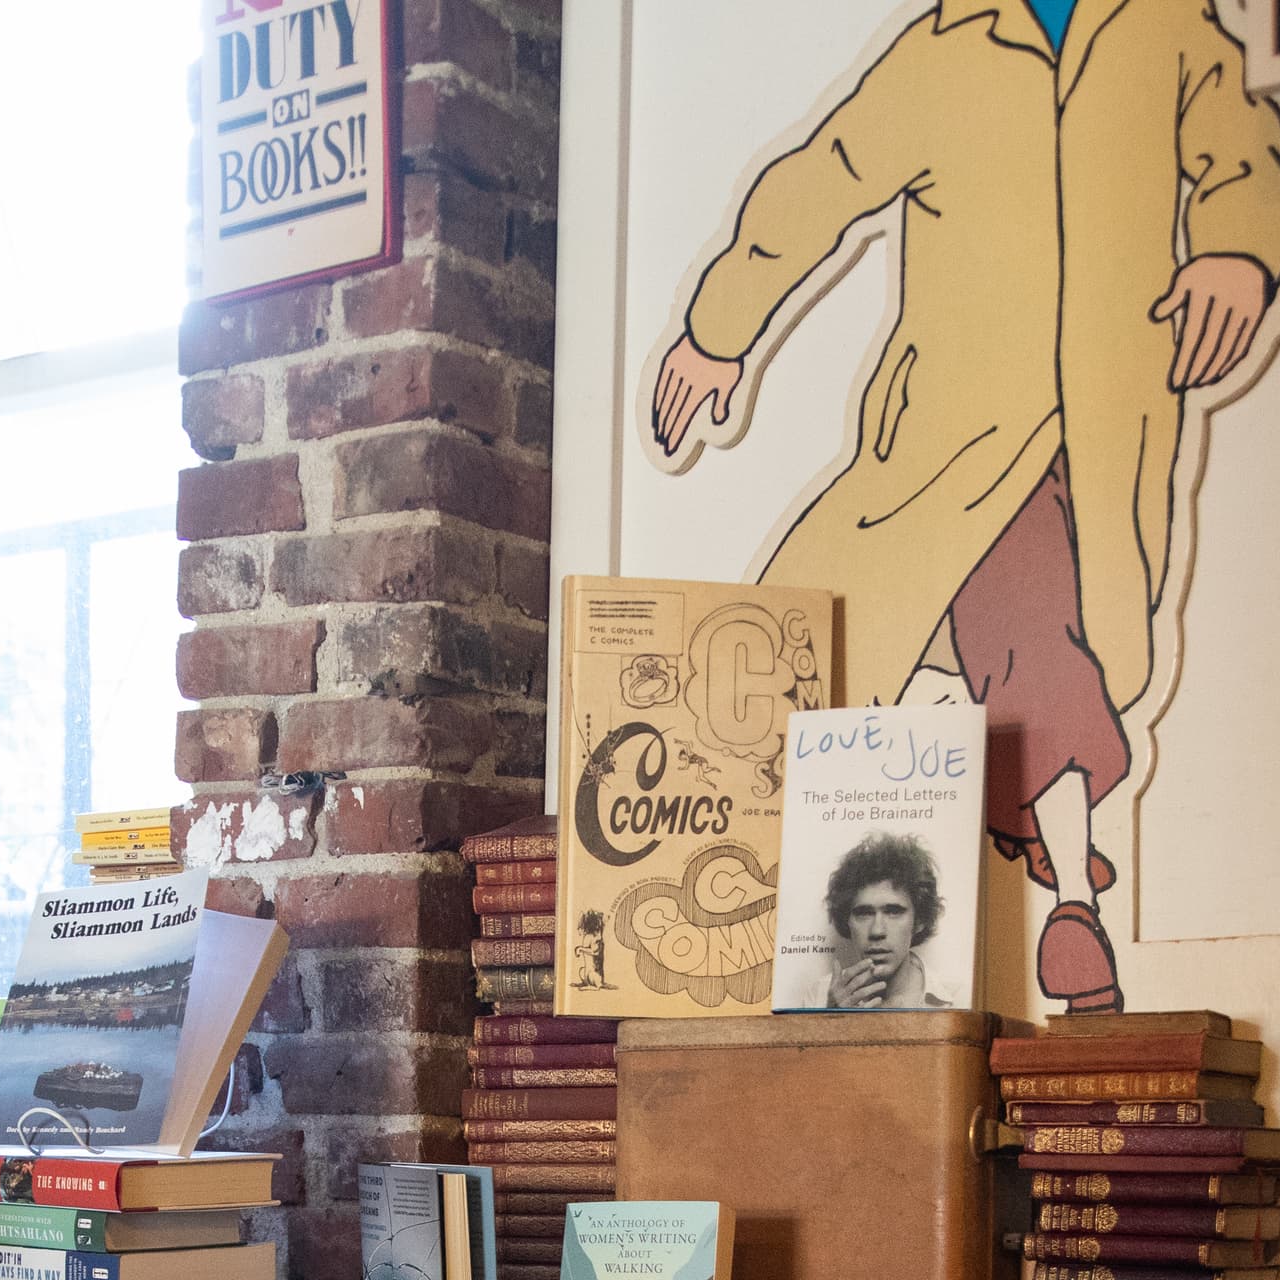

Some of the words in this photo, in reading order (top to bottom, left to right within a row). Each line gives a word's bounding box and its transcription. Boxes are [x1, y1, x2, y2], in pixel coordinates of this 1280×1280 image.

[217, 0, 361, 104] DUTY
[273, 89, 310, 127] ON
[218, 113, 367, 215] BOOKS!!
[589, 626, 606, 634] THE
[611, 626, 655, 636] COMPLETE
[796, 716, 894, 760] LOVE,
[881, 728, 967, 781] JOE
[802, 791, 829, 805] The
[834, 788, 898, 803] Selected
[904, 787, 957, 801] Letters
[609, 795, 734, 835] COMICS
[822, 808, 836, 821] of
[840, 808, 864, 821] Joe
[870, 806, 934, 820] Brainard
[42, 897, 135, 918] Sliammon
[142, 886, 179, 906] Life,
[50, 918, 143, 940] Sliammon
[150, 904, 198, 930] Lands
[781, 945, 810, 954] Daniel
[813, 945, 836, 954] Kane
[37, 1175, 52, 1189] THE
[55, 1176, 93, 1191] KNOWING
[591, 1219, 604, 1229] AN
[606, 1219, 669, 1229] ANTHOLOGY
[671, 1219, 686, 1228] OF
[579, 1233, 634, 1245] WOMEN'S
[638, 1233, 697, 1245] WRITING
[617, 1250, 652, 1259] ABOUT
[17, 1267, 35, 1280] FIND
[37, 1269, 42, 1280] A
[605, 1263, 663, 1274] WALKING
